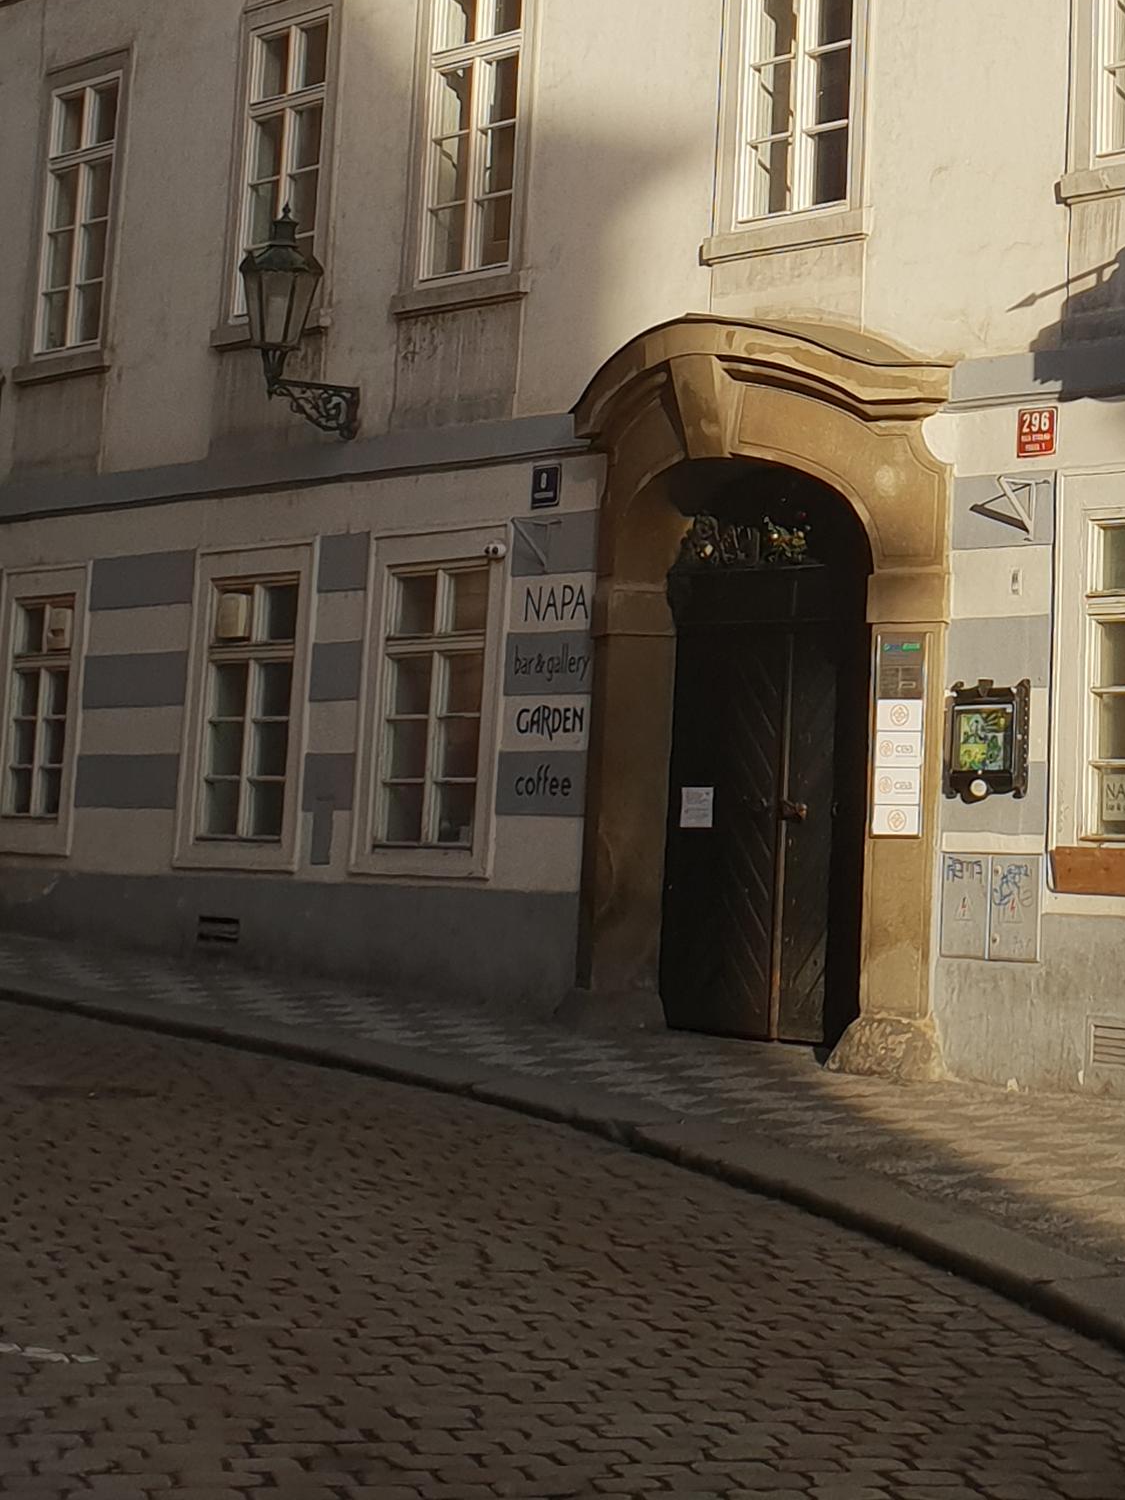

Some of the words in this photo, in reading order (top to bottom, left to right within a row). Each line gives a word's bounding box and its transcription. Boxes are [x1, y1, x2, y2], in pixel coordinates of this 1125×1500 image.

[1022, 412, 1050, 433] 296
[523, 584, 589, 622] NAPA
[516, 705, 584, 742] GARDEN
[515, 764, 572, 797] coffee
